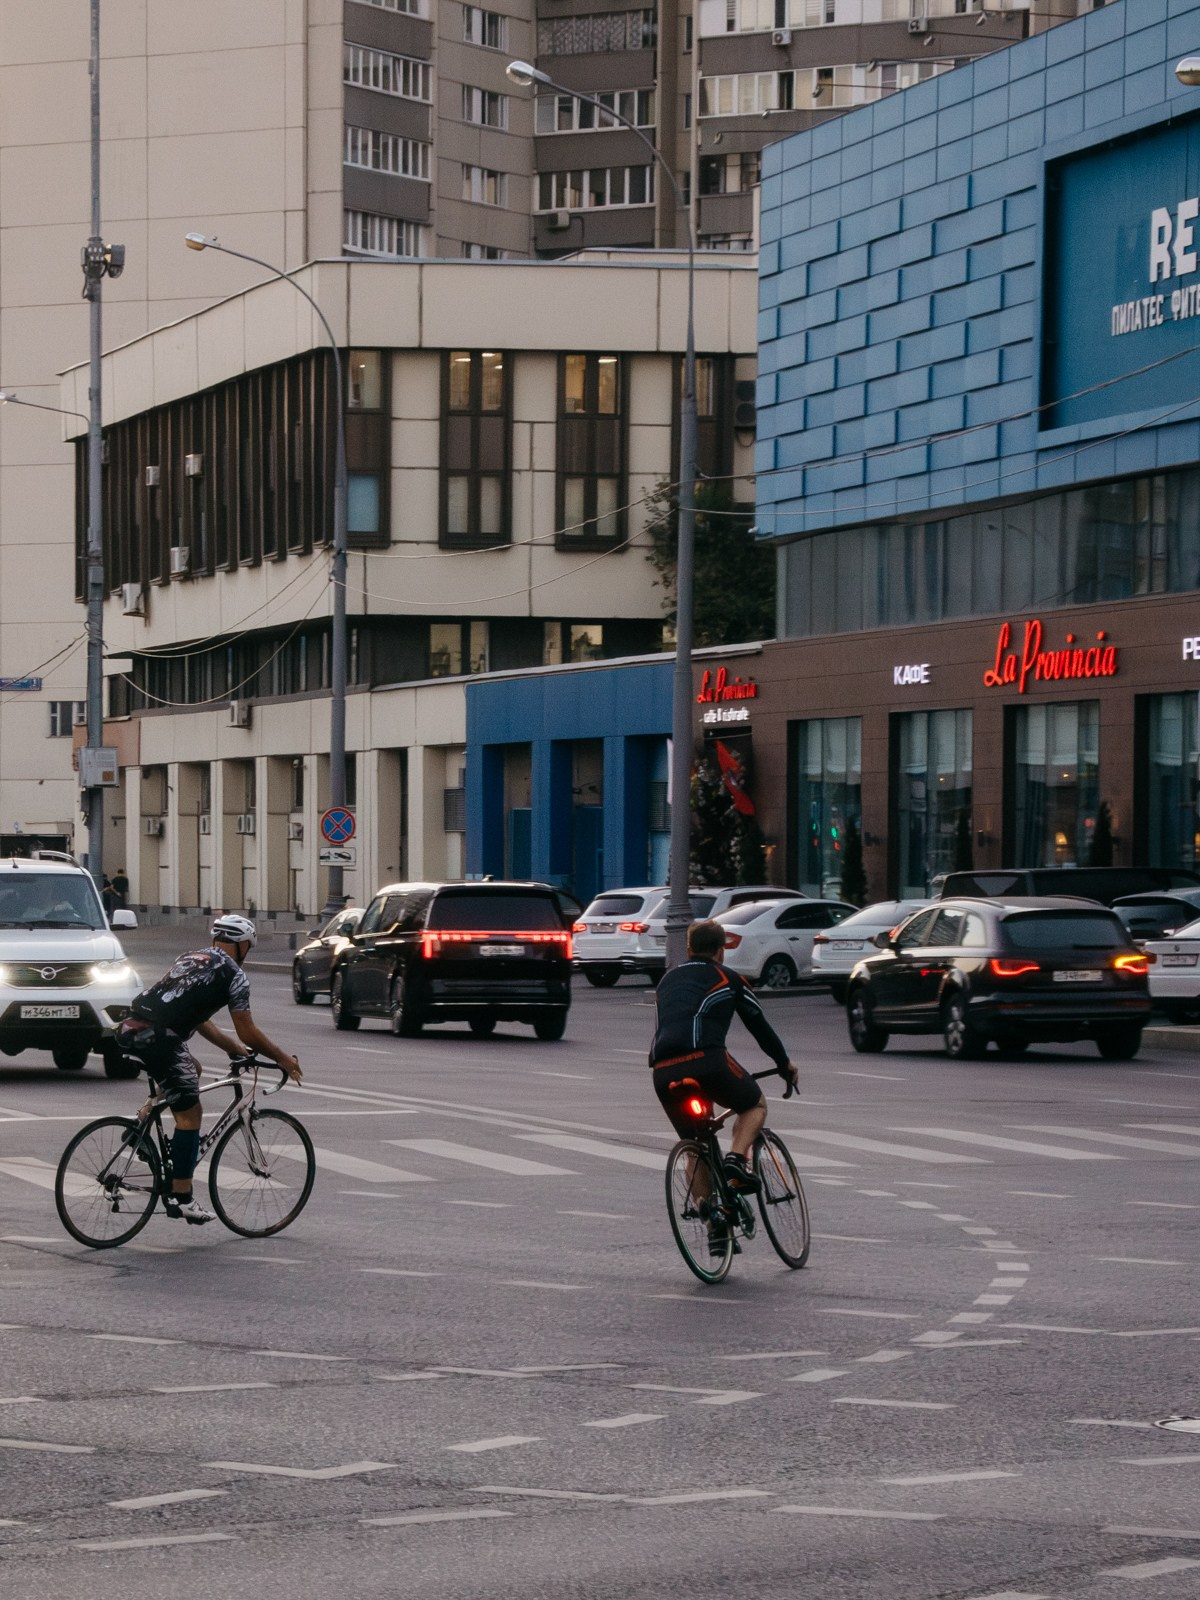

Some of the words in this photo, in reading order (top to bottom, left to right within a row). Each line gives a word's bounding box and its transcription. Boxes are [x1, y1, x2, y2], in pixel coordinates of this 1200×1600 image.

[1111, 294, 1164, 336] ПИЛАТЕС
[893, 663, 931, 685] КАФЕ
[984, 622, 1017, 686] La
[1018, 620, 1117, 694] Provincia
